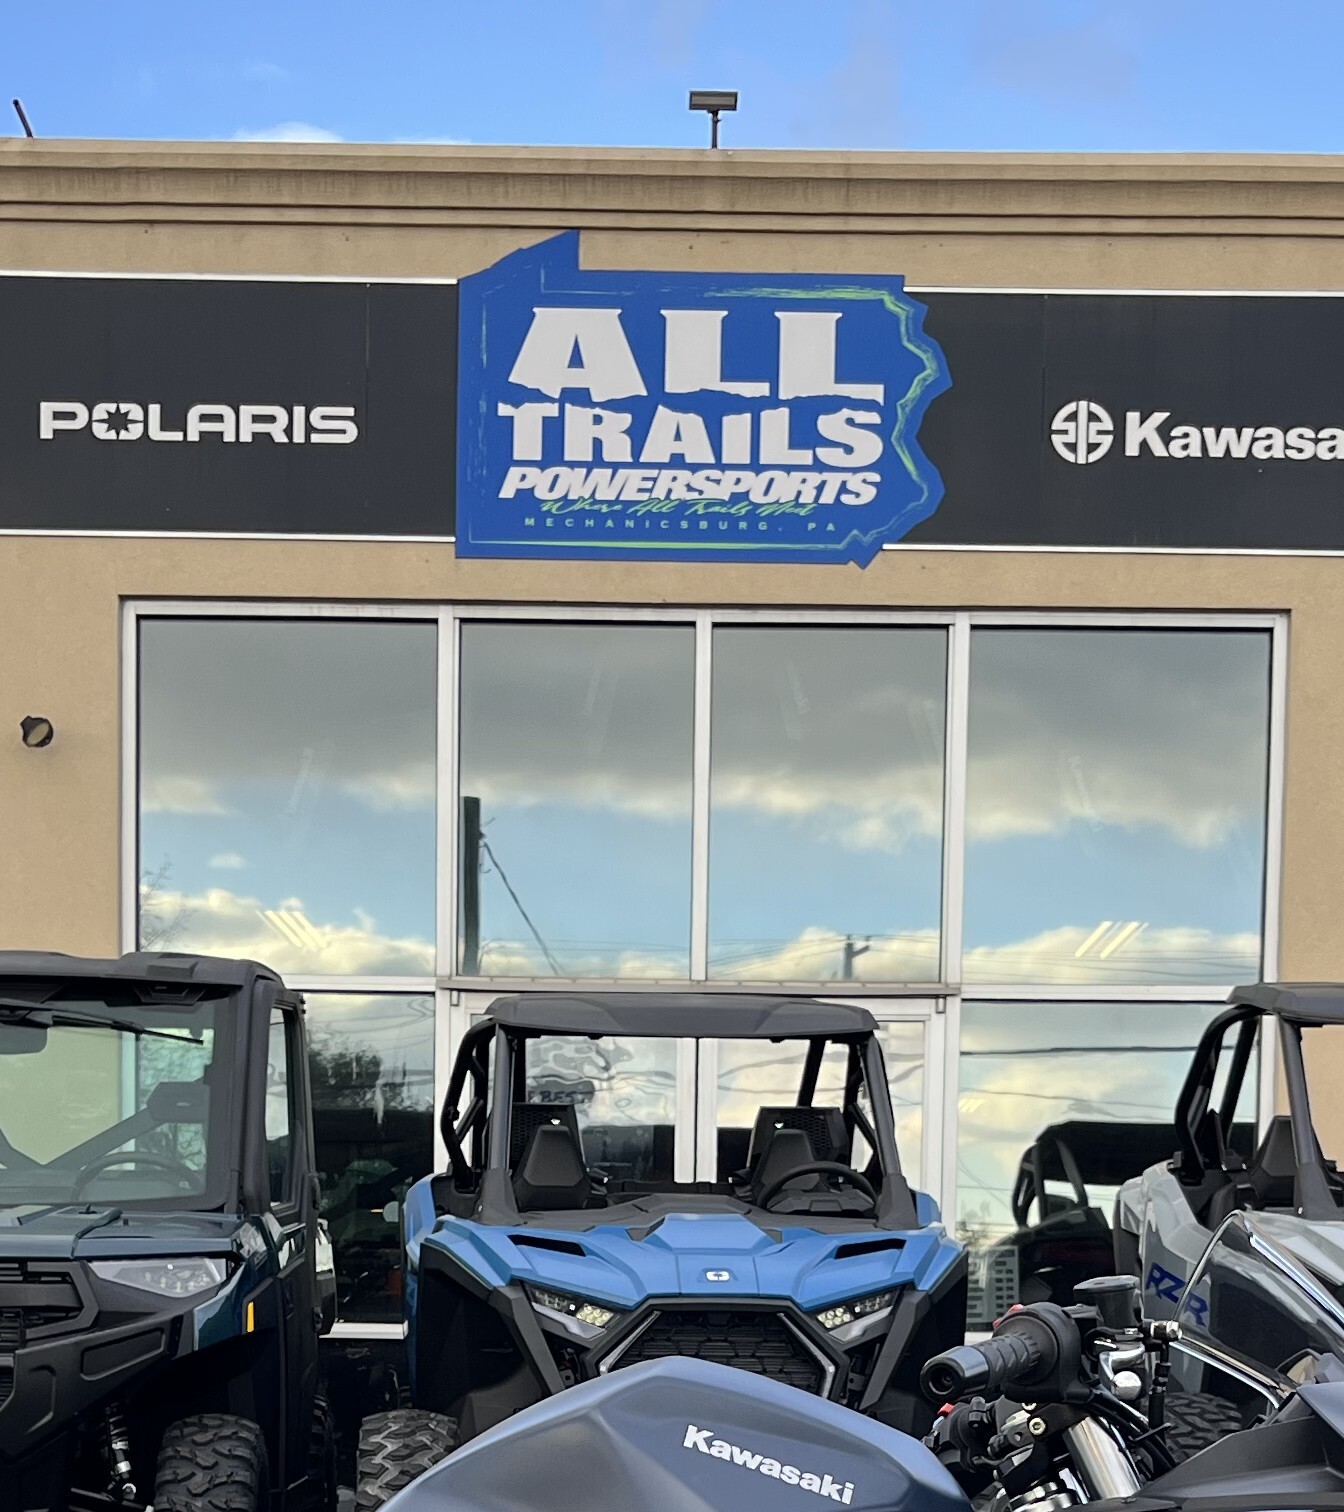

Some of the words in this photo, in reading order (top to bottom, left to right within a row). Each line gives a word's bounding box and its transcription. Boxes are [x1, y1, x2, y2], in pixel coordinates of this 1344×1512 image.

[508, 307, 885, 406] ALL
[39, 401, 360, 445] POLARIS
[497, 402, 884, 468] TRAILS
[498, 466, 882, 506] POWERSPORTS
[540, 496, 623, 515] Where
[625, 498, 680, 517] All
[683, 498, 754, 517] Trails
[807, 522, 836, 532] PA
[1145, 1262, 1209, 1328] RZR
[682, 1424, 855, 1505] Kawasaki
